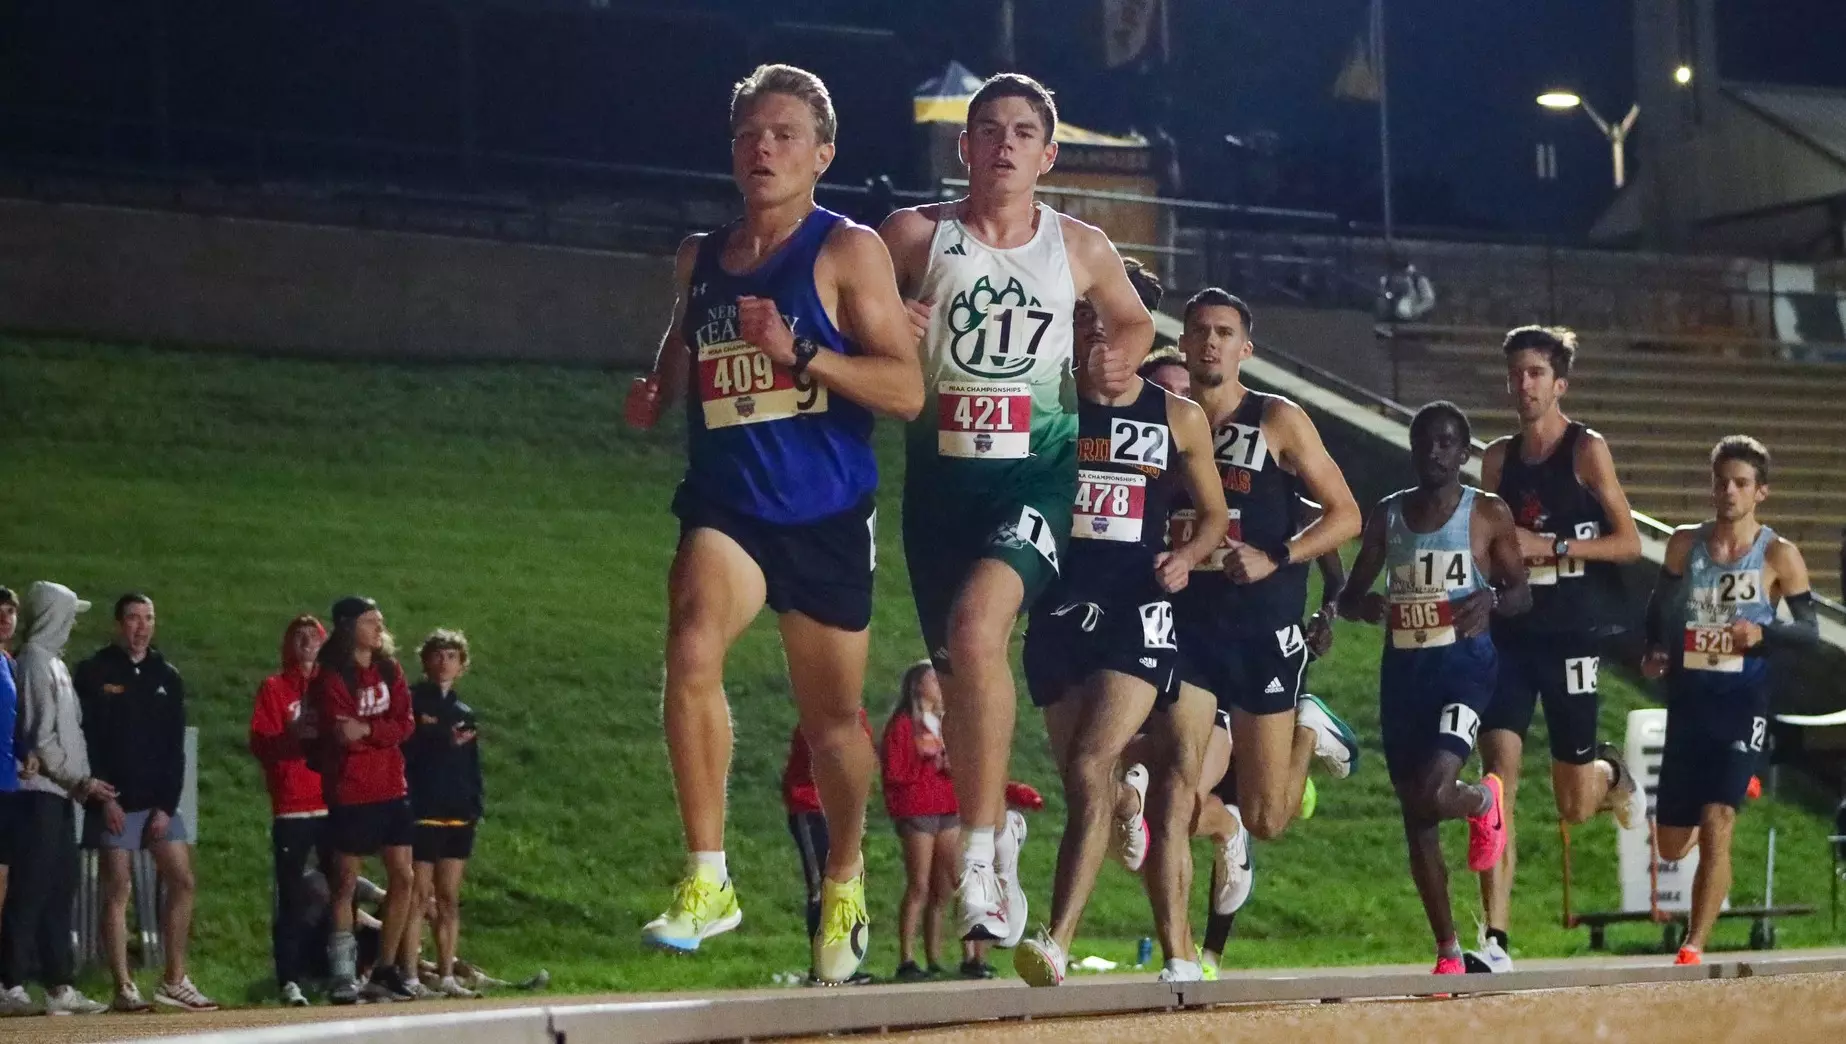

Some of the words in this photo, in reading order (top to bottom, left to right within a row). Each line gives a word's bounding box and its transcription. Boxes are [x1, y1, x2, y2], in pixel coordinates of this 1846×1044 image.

[993, 308, 1054, 356] 17
[713, 353, 774, 395] 409
[954, 396, 1013, 430] 421
[1114, 422, 1163, 466] 22
[1213, 424, 1260, 466] 21
[1087, 473, 1137, 483] CHAMPIONSHIPS
[1074, 482, 1130, 516] 478
[1419, 552, 1467, 586] 14
[1720, 573, 1756, 601] 23
[1400, 602, 1440, 629] 506
[1695, 629, 1734, 654] 520
[1751, 719, 1764, 748] 2
